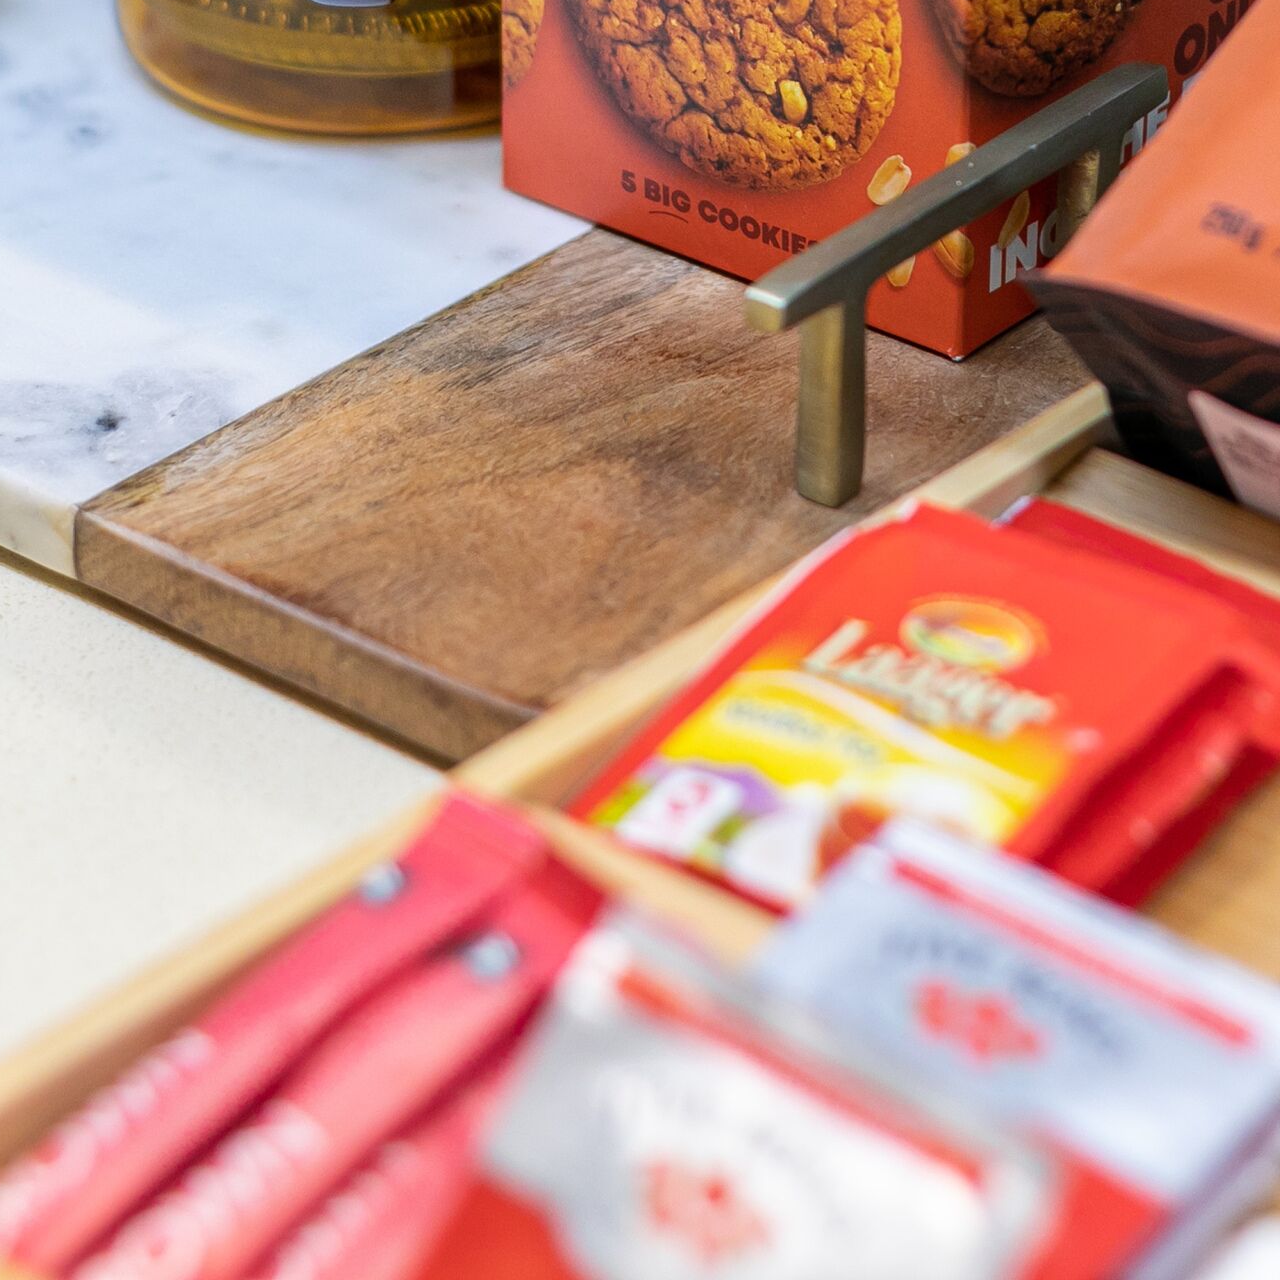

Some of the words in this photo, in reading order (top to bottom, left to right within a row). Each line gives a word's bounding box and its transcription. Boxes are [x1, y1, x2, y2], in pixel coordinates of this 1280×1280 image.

[622, 170, 637, 193] 5
[644, 177, 691, 213] BIG
[697, 199, 820, 255] COOKIE
